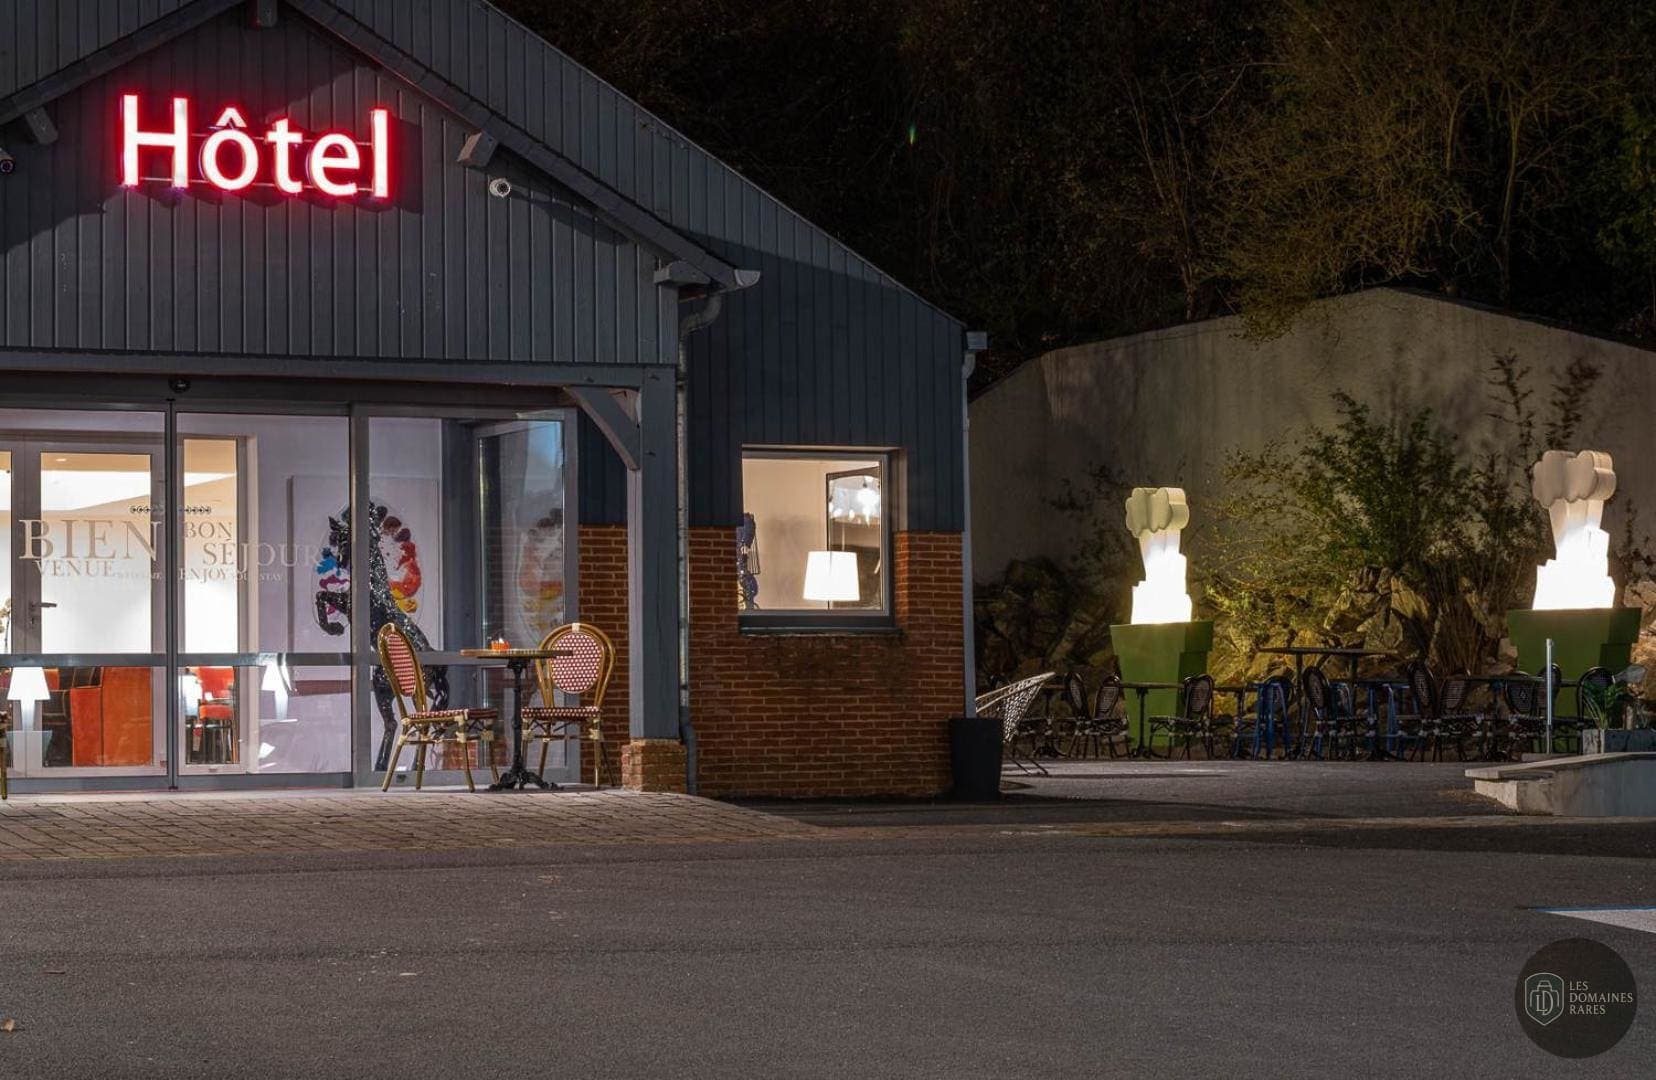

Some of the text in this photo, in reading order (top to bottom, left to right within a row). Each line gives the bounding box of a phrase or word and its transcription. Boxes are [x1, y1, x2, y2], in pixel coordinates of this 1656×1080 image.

[123, 94, 388, 198] Hôtel
[184, 521, 232, 538] BON
[18, 519, 162, 562] BIEN
[34, 560, 115, 577] VENUE
[179, 567, 227, 583] ENJOY
